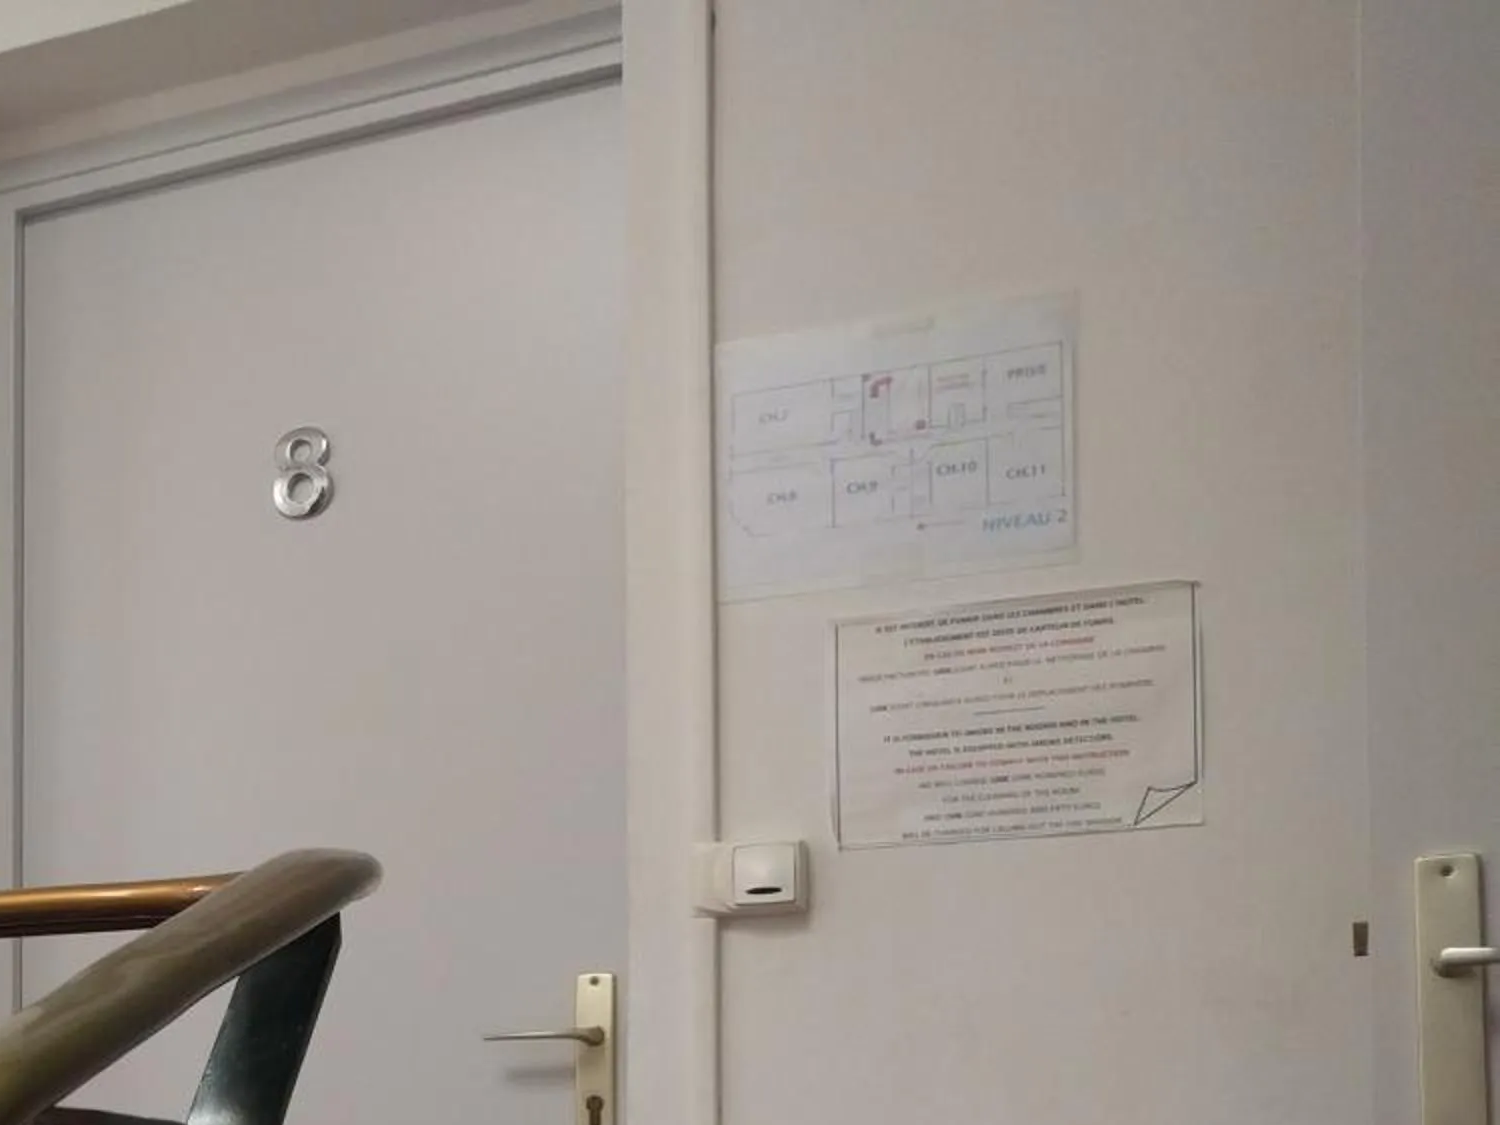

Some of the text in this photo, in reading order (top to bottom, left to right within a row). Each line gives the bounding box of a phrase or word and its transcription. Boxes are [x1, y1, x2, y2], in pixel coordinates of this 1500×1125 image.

[272, 426, 334, 521] 8
[982, 509, 1068, 532] NIVEAU 2
